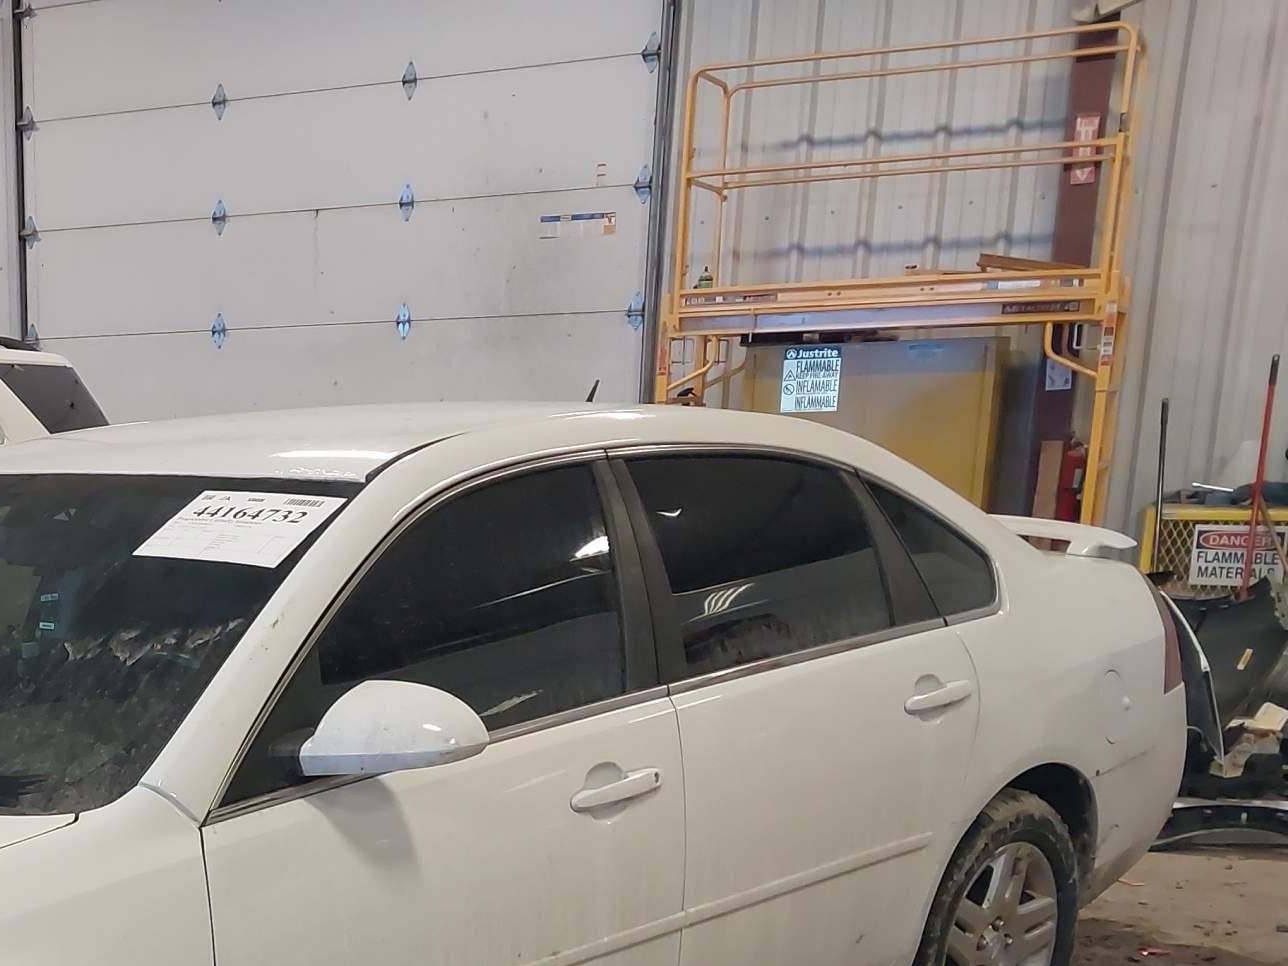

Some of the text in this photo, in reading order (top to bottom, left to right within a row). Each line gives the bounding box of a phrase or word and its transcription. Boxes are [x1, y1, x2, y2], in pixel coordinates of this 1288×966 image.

[797, 348, 839, 358] Justrite
[797, 359, 840, 372] FLAMMABLE
[796, 379, 838, 392] INFLAMABLE
[795, 395, 837, 408] INFLAMMABLE
[193, 505, 308, 524] 44164732
[1197, 551, 1280, 565] FLAMMBLE
